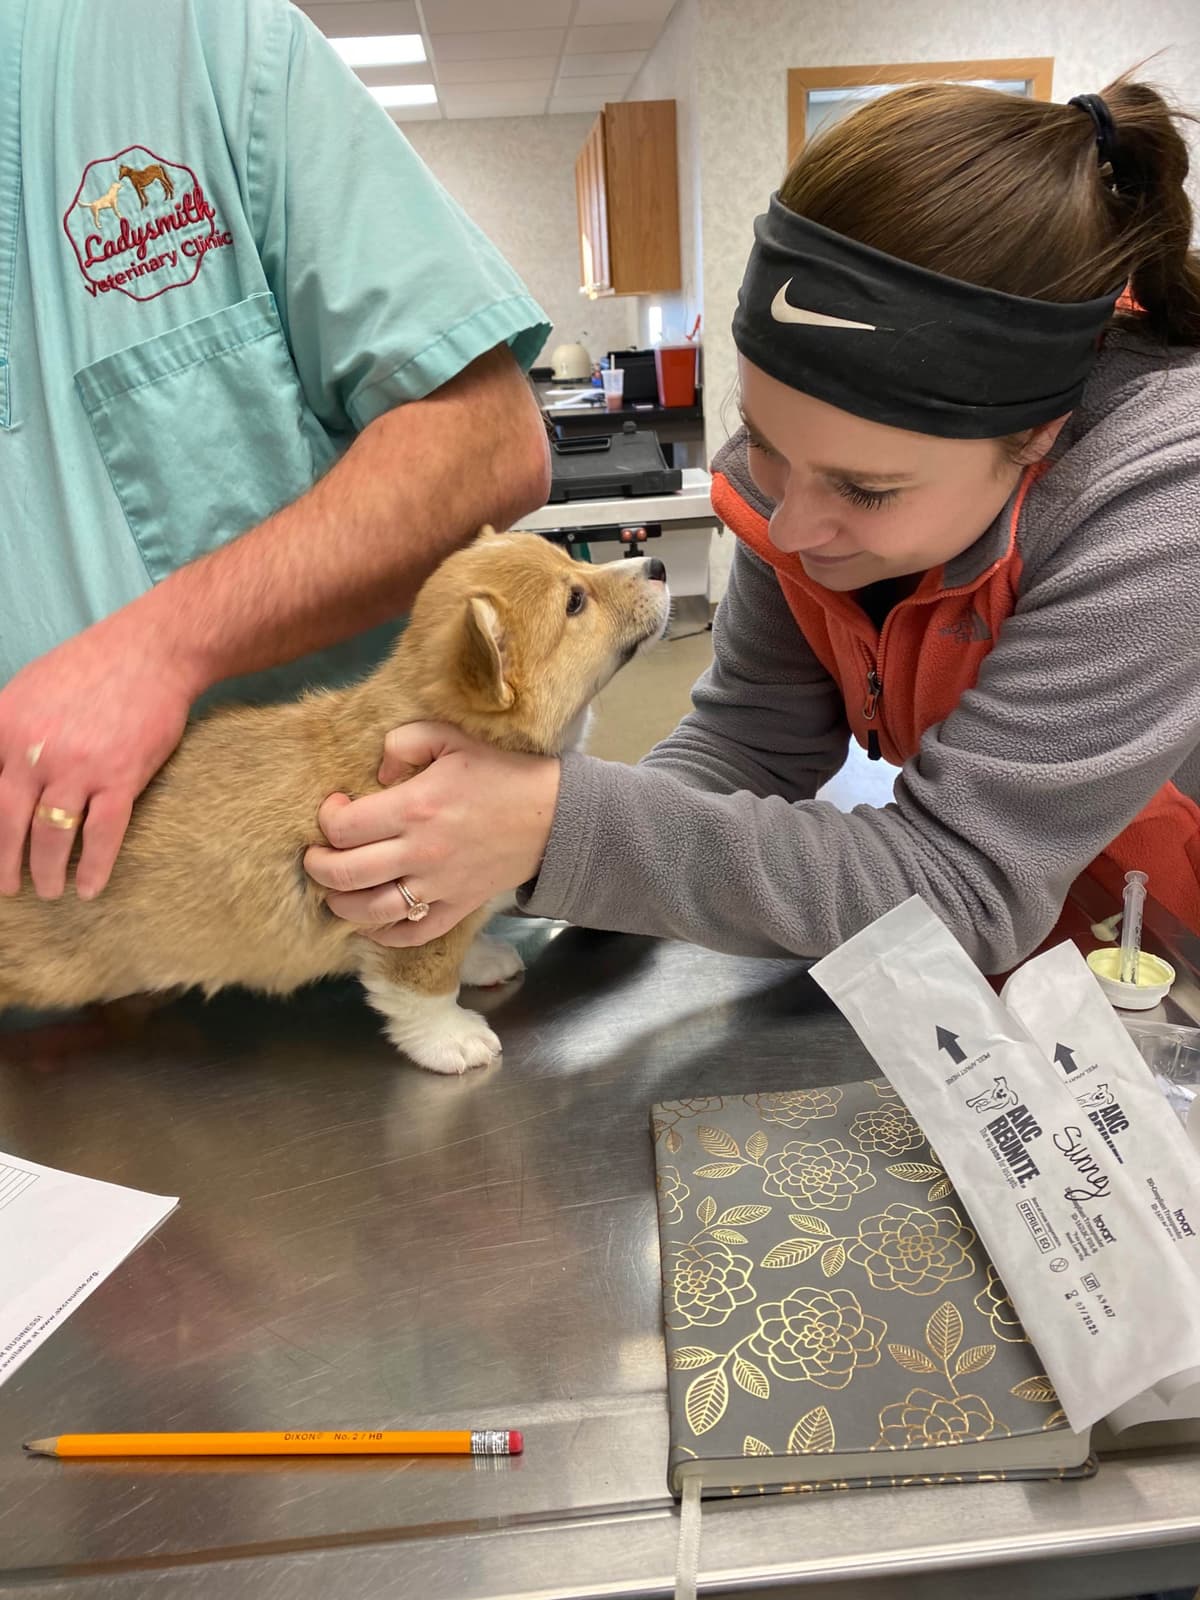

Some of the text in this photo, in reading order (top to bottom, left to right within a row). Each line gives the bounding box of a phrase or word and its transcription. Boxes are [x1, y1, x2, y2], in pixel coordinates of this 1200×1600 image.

[84, 187, 216, 268] Ladysmith
[181, 230, 234, 258] Clinic
[1005, 1104, 1043, 1143] AKC
[1098, 1103, 1130, 1134] AKC
[1020, 1202, 1051, 1250] STERILE EO
[1083, 1274, 1099, 1291] LOT
[2, 1339, 32, 1368] available
[369, 1431, 383, 1440] HB
